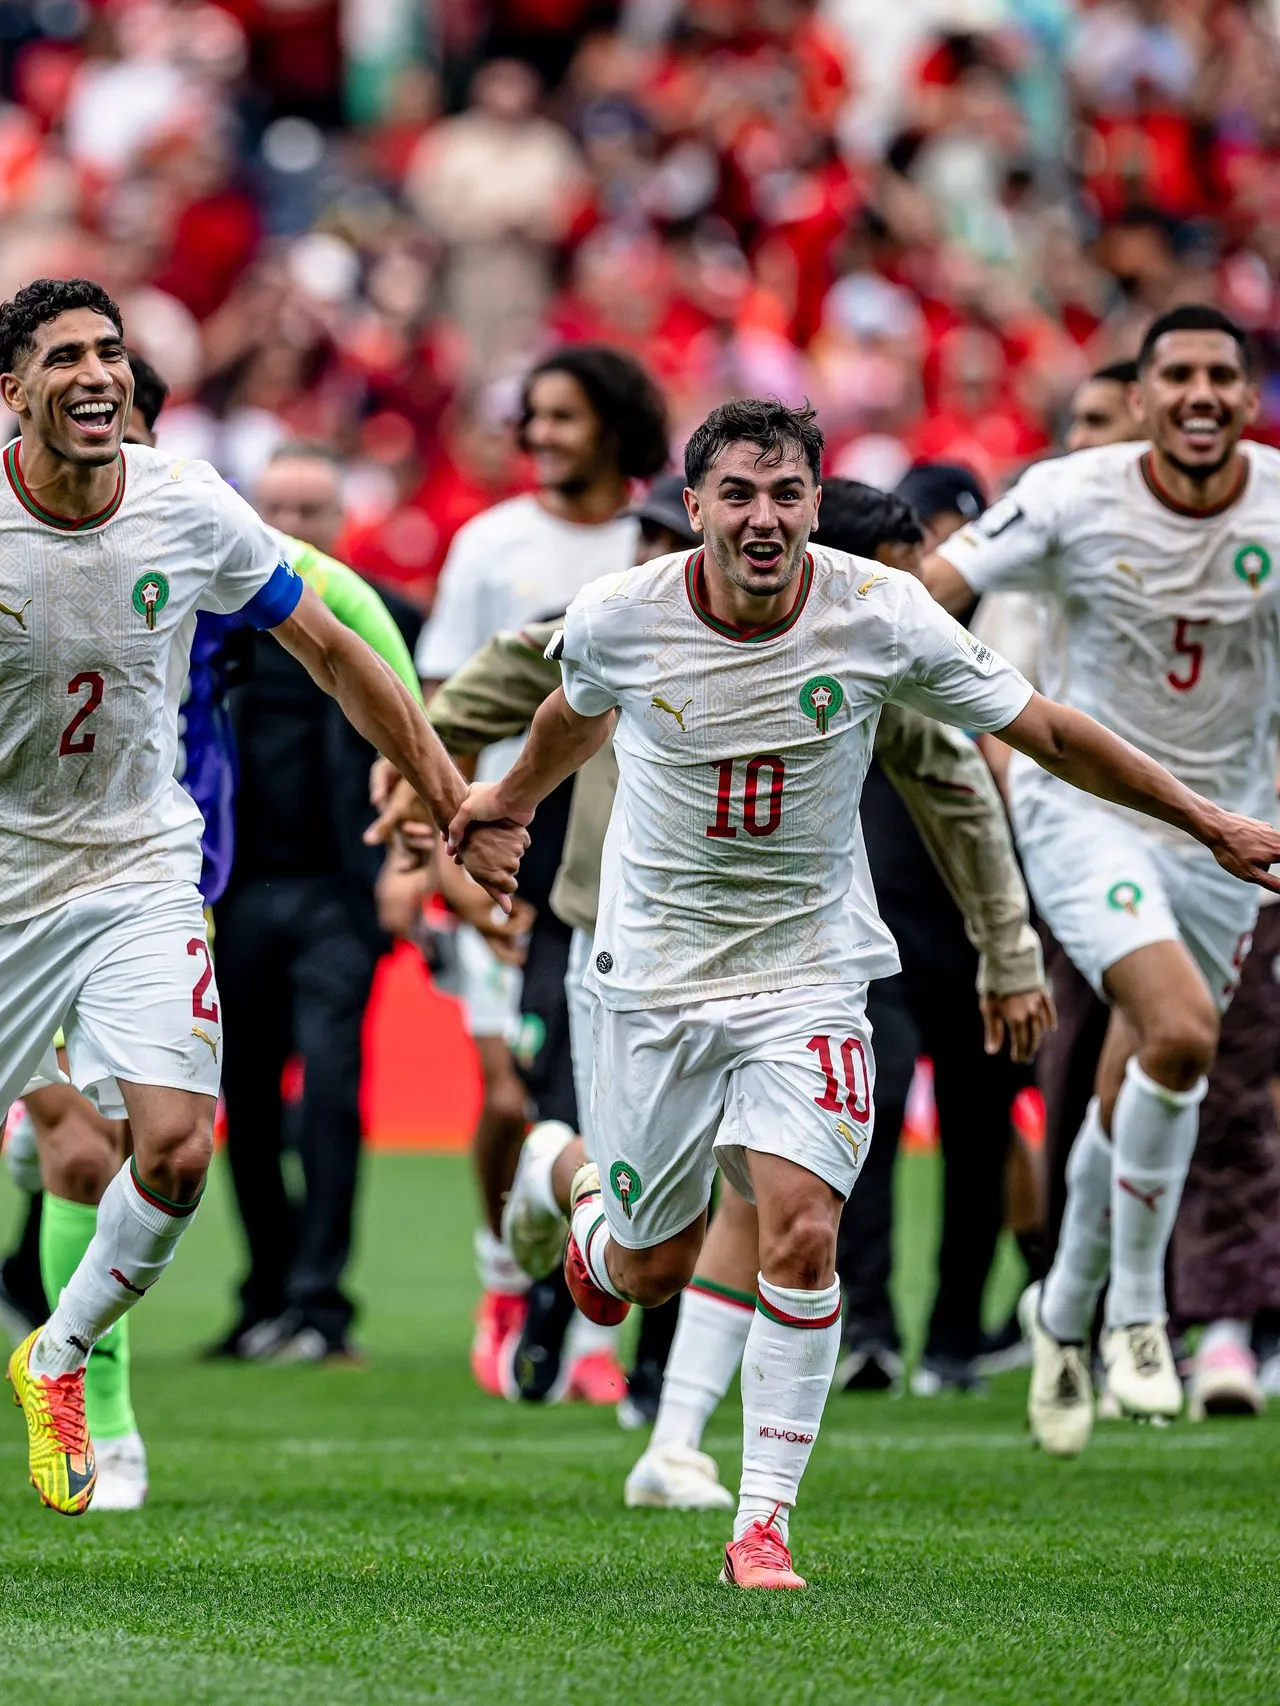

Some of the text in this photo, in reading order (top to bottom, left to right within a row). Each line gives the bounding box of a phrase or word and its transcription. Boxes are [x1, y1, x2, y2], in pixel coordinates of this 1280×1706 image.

[1166, 618, 1211, 693] 5
[59, 671, 104, 757] 2
[706, 754, 786, 838] 10
[184, 937, 220, 1022] 2
[805, 1034, 872, 1125] 10
